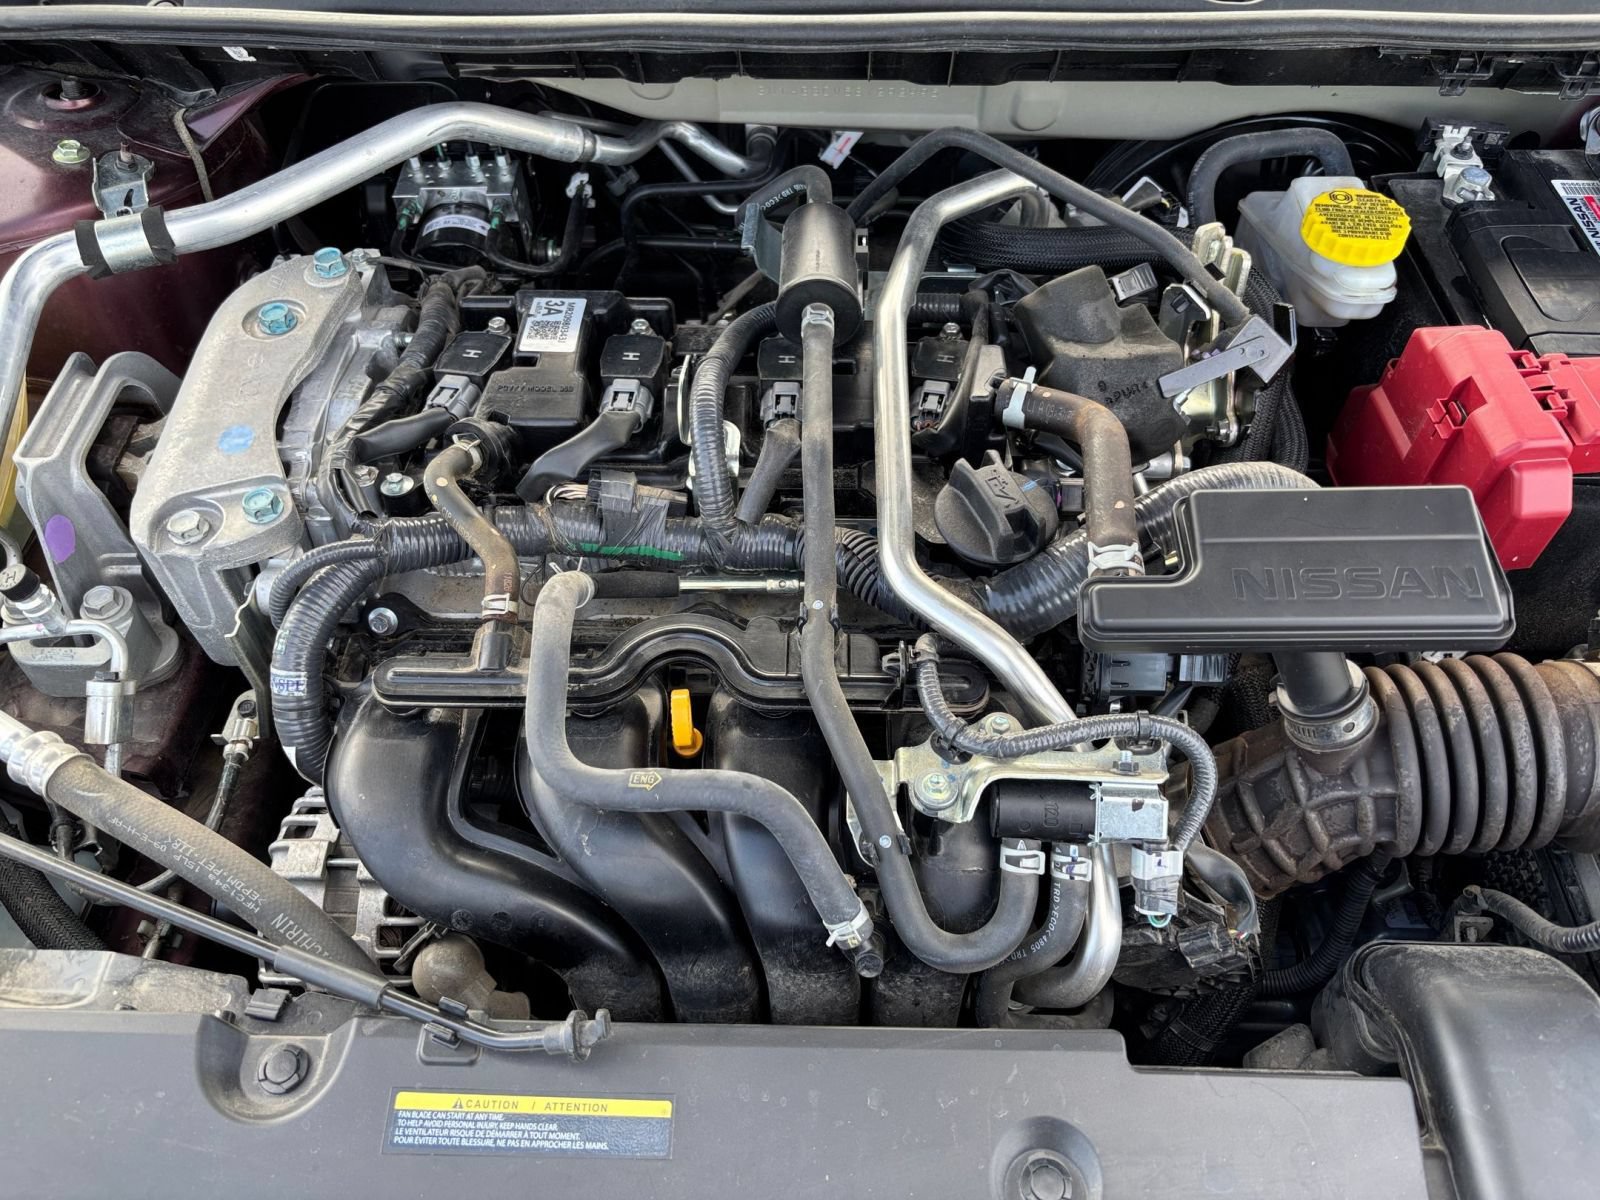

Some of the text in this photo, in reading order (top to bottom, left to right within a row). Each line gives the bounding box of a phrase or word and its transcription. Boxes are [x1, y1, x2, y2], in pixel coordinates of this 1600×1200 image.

[1566, 197, 1600, 239] NISSAN
[542, 300, 565, 316] 3A
[1231, 565, 1484, 600] NISSAN
[633, 774, 655, 784] ENG
[465, 1099, 519, 1110] CAUTION
[544, 1102, 609, 1113] ATTENTION
[398, 1110, 411, 1118] FAN
[412, 1111, 432, 1119] BLADE
[432, 1111, 446, 1119] CAN
[465, 1112, 474, 1120] AT
[398, 1119, 406, 1127] TO
[423, 1120, 443, 1128] AVOID
[444, 1120, 475, 1129] PERSONAL
[499, 1122, 514, 1130] KEEP
[515, 1122, 537, 1131] HANDS
[405, 1128, 448, 1136] VENTILATEUR
[450, 1129, 477, 1138] RISQUE
[478, 1130, 488, 1138] DE
[489, 1129, 521, 1138] DÉMARRER
[530, 1131, 547, 1140] TOUT
[548, 1132, 580, 1140] MOMENT.
[393, 1136, 414, 1144] POUR
[415, 1135, 437, 1145] ÉVITER
[438, 1137, 461, 1145] TOUTE
[496, 1139, 507, 1147] NE
[508, 1139, 520, 1147] PAS
[520, 1140, 530, 1148] EN
[531, 1140, 572, 1149] APPROCHER
[572, 1141, 585, 1149] LES
[585, 1141, 609, 1150] MAINS.
